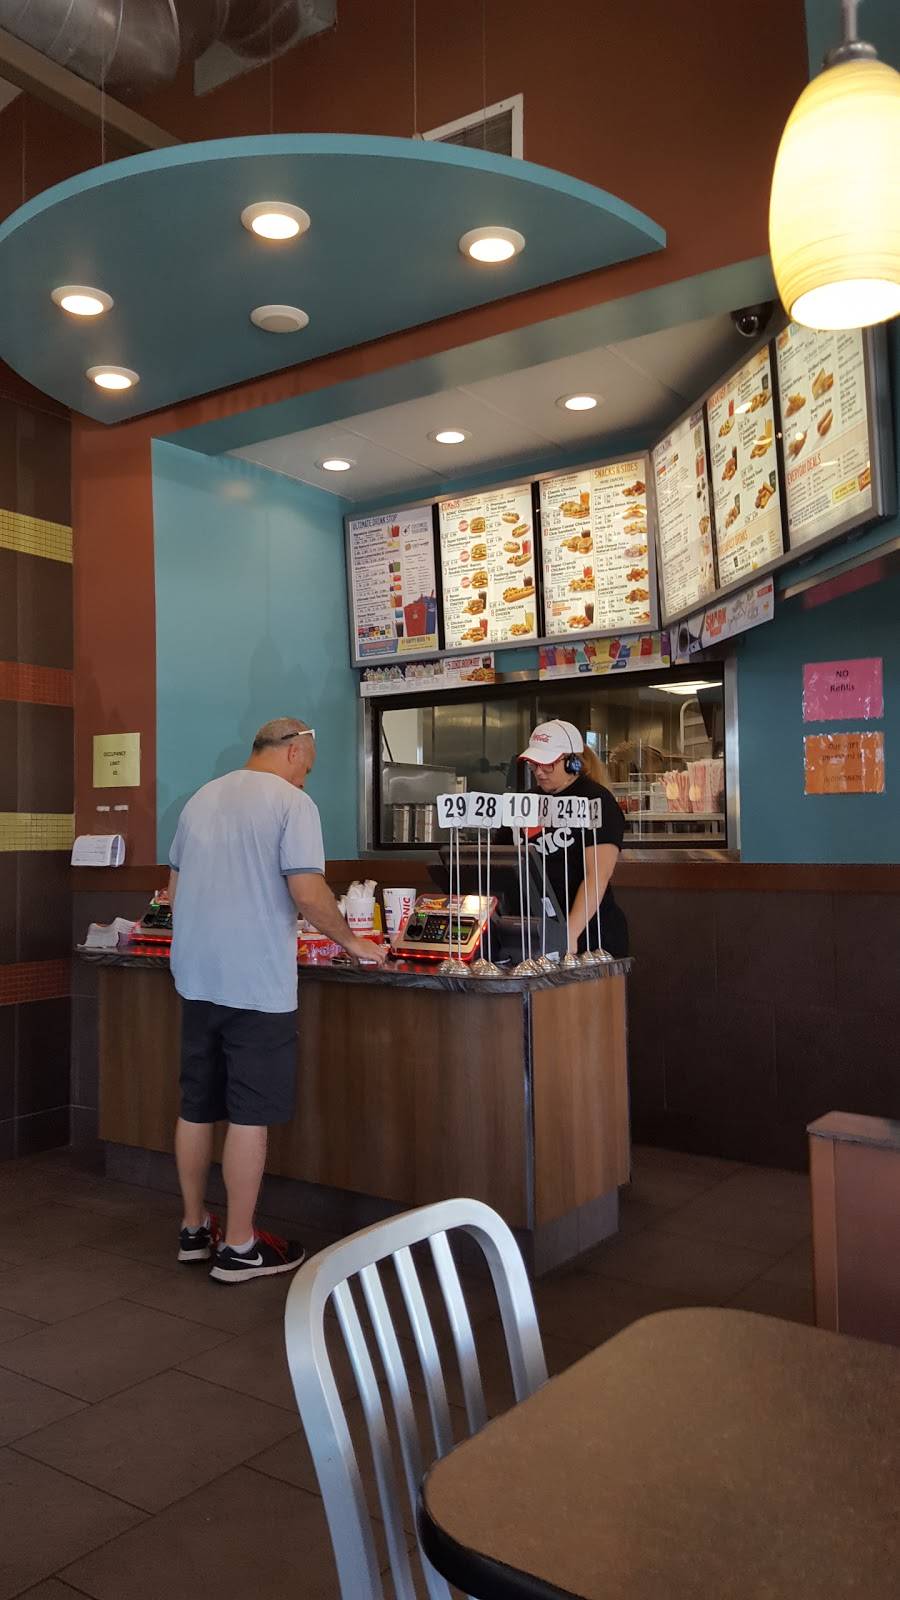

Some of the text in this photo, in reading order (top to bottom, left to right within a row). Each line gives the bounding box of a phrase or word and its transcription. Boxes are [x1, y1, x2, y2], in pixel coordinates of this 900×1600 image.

[594, 467, 615, 479] SNACKS
[621, 462, 638, 473] SIDES
[444, 796, 466, 818] 29
[475, 796, 497, 818] 28
[509, 796, 531, 816] 10
[538, 796, 549, 818] 18
[558, 800, 574, 818] 24
[402, 896, 410, 922] ONIC
